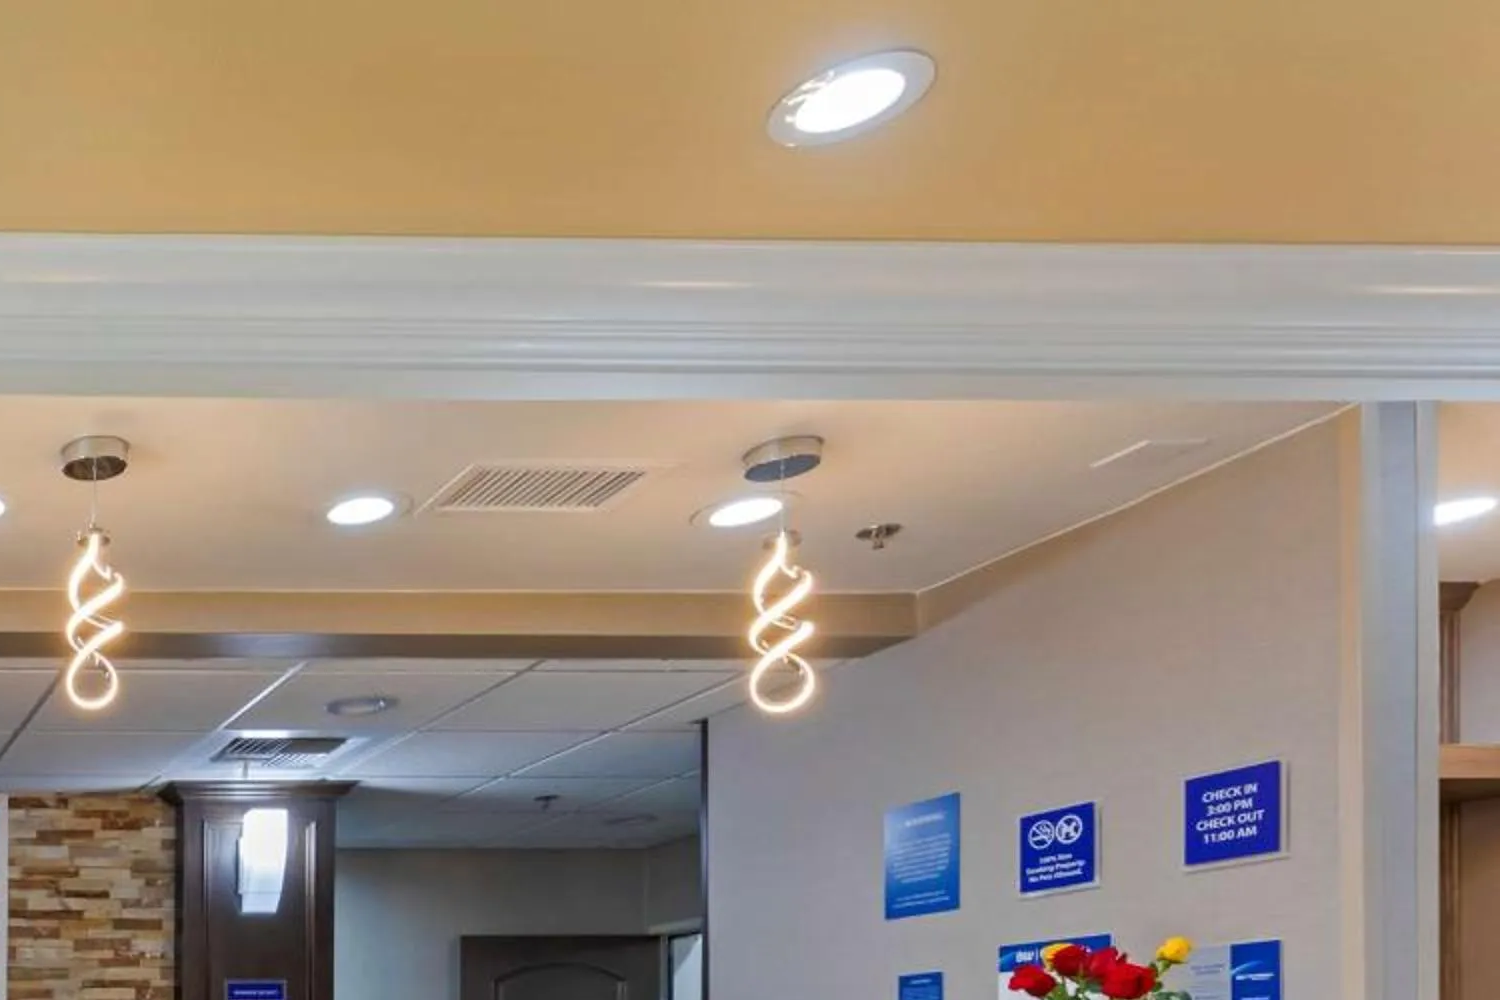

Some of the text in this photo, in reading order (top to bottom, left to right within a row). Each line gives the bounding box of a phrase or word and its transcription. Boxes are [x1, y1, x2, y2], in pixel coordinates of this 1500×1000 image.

[1202, 783, 1258, 803] CHECK IN
[1206, 797, 1253, 816] 3:00 PM
[1196, 809, 1265, 831] CHECK OUT
[1203, 825, 1257, 844] 11:00 AM
